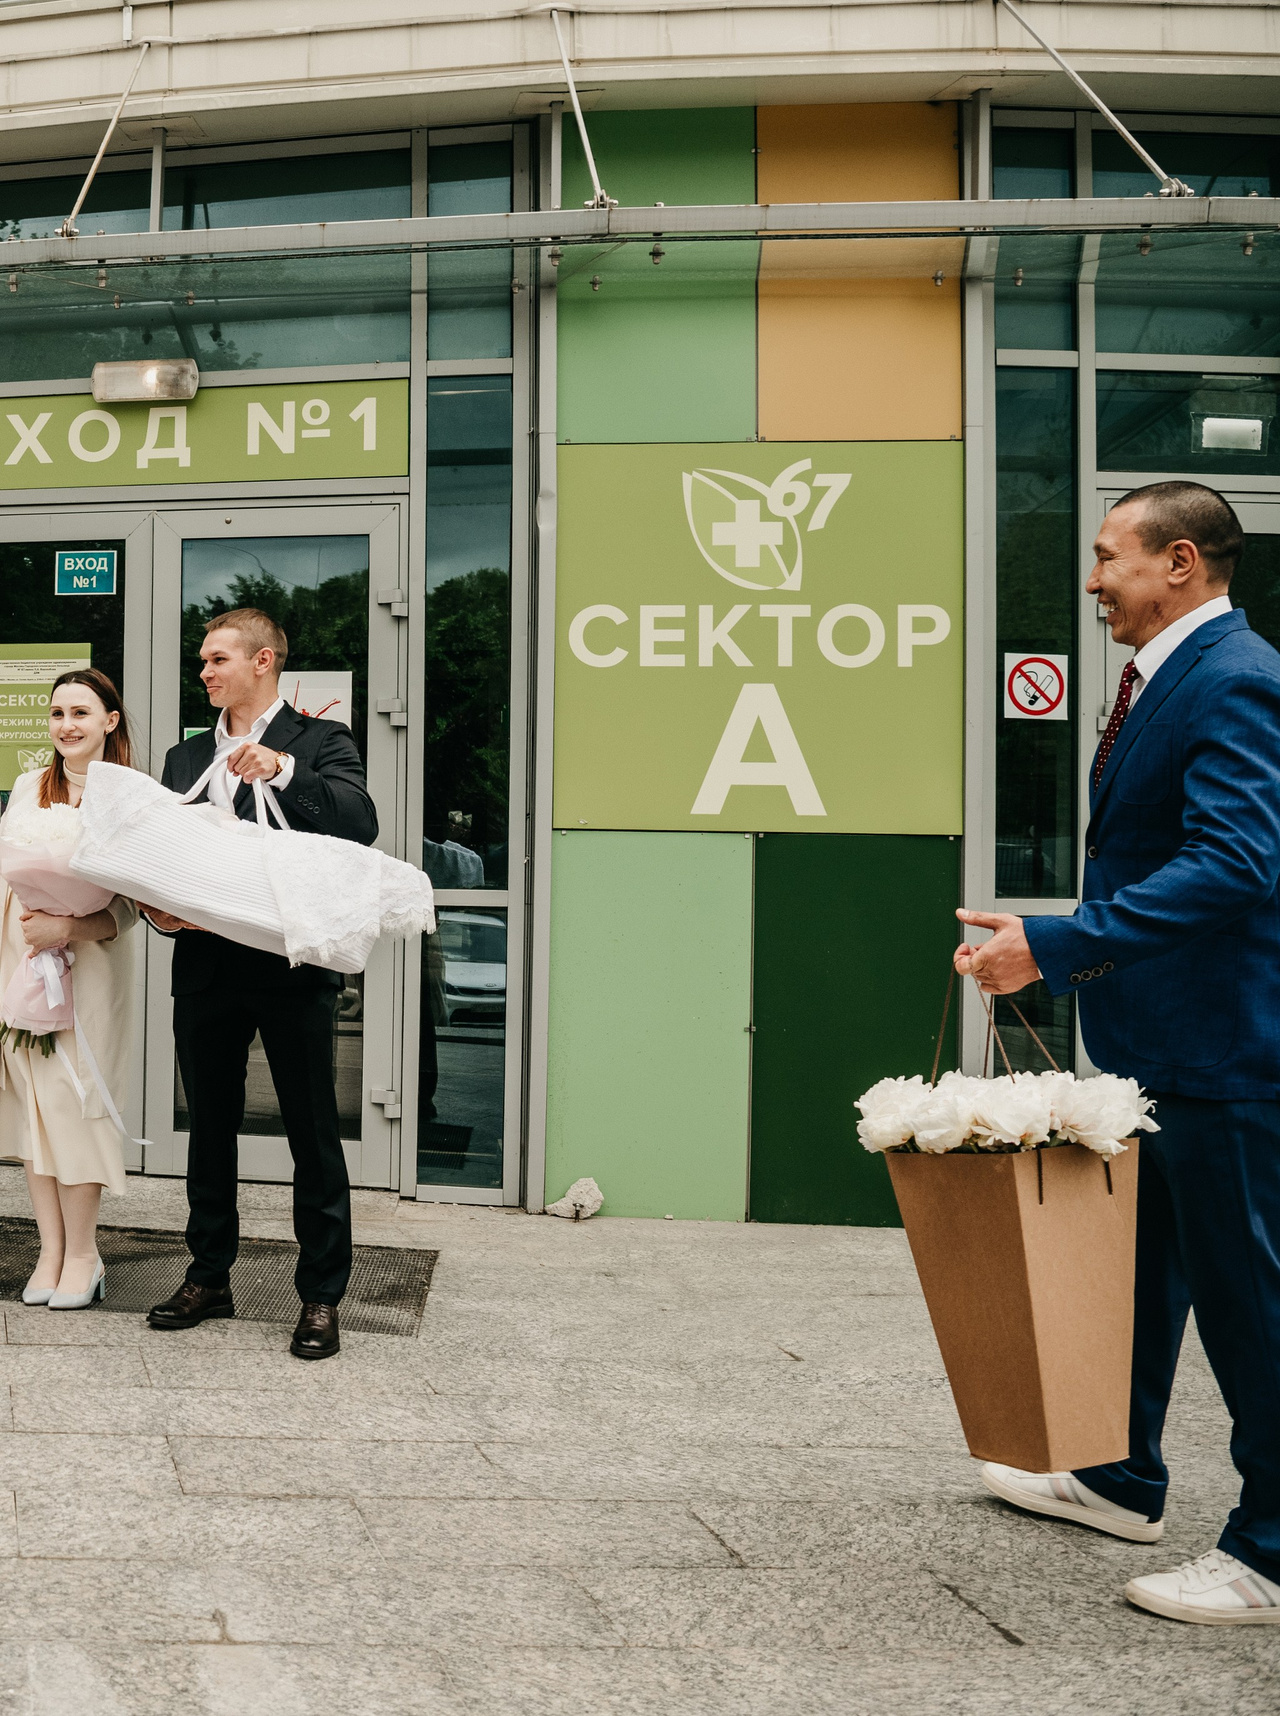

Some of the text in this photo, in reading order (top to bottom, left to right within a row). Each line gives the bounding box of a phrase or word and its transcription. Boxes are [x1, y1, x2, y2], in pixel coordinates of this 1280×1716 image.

[246, 396, 377, 456] №1
[766, 458, 853, 532] 67
[64, 557, 108, 572] ВХОД
[73, 575, 97, 588] №1
[568, 603, 951, 669] СЕКТОР
[34, 747, 53, 765] 67
[690, 683, 828, 816] А
